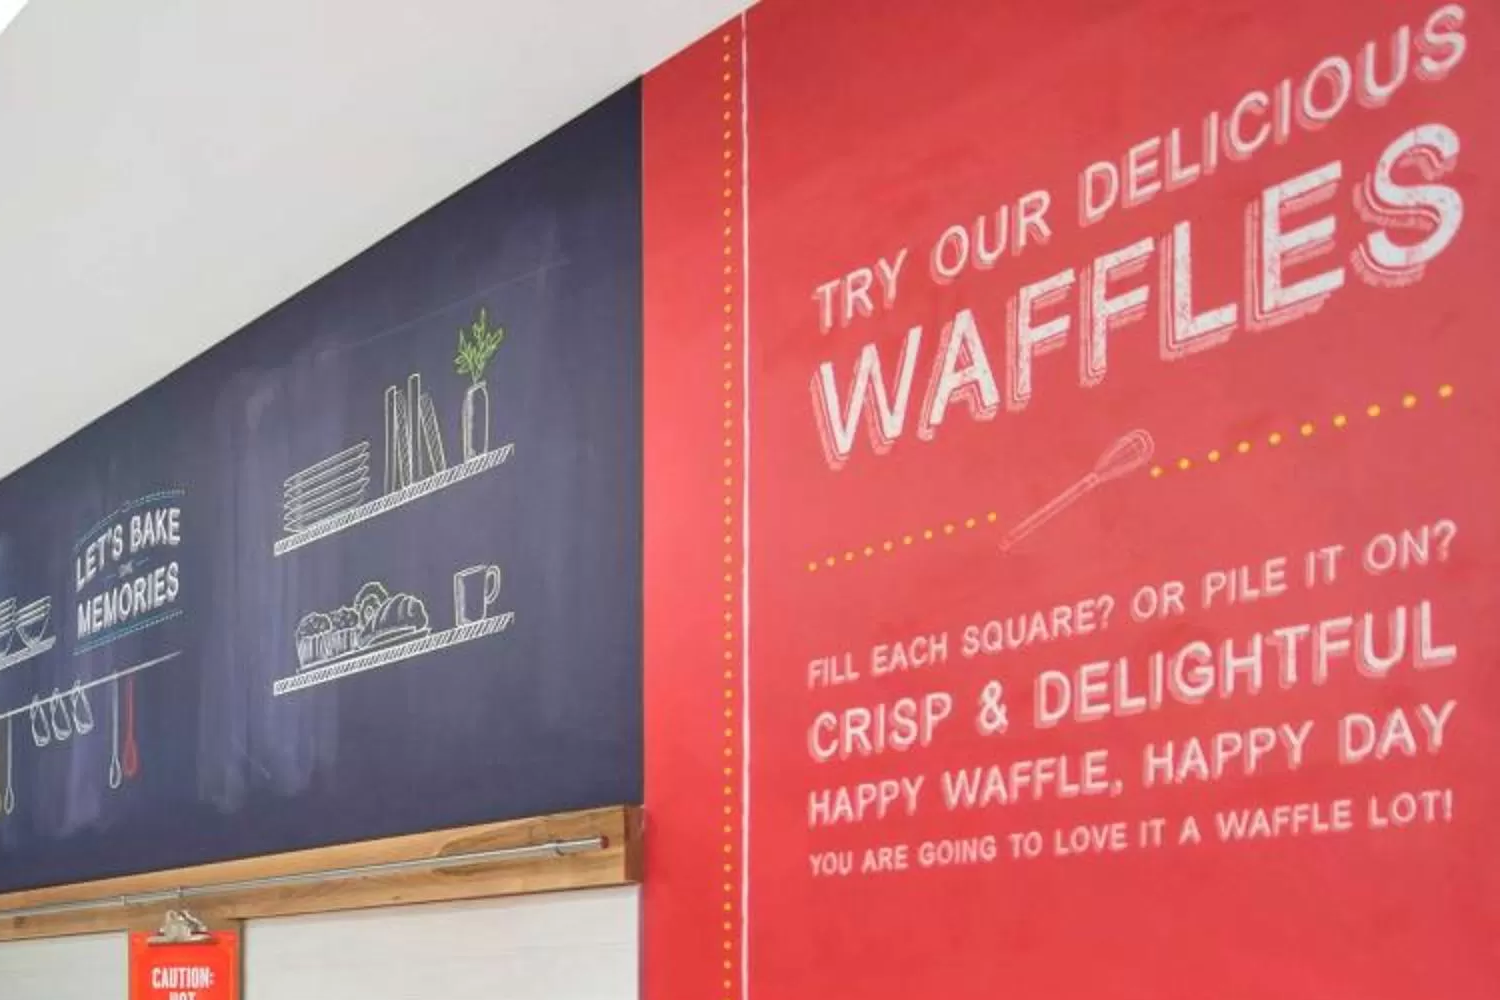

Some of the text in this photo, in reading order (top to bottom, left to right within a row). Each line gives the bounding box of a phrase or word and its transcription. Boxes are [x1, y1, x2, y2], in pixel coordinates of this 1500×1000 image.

[811, 3, 1466, 333] TRY OUR DELICIOUS
[811, 123, 1464, 469] WAFFLES
[76, 506, 181, 593] LET'S BAKE
[77, 561, 180, 641] MEMORIES
[807, 519, 1457, 689] FILL EACH SQUARE? OR PILE IT ON?
[808, 600, 1457, 762] CRISP & DELIGHTFUL
[807, 701, 1457, 827] HAPPY WAFFLE, HAPPY DAY
[809, 789, 1453, 877] YOU ARE GOING TO LOVE IT A WAFFLE LOT!
[151, 966, 215, 990] CAUTION:
